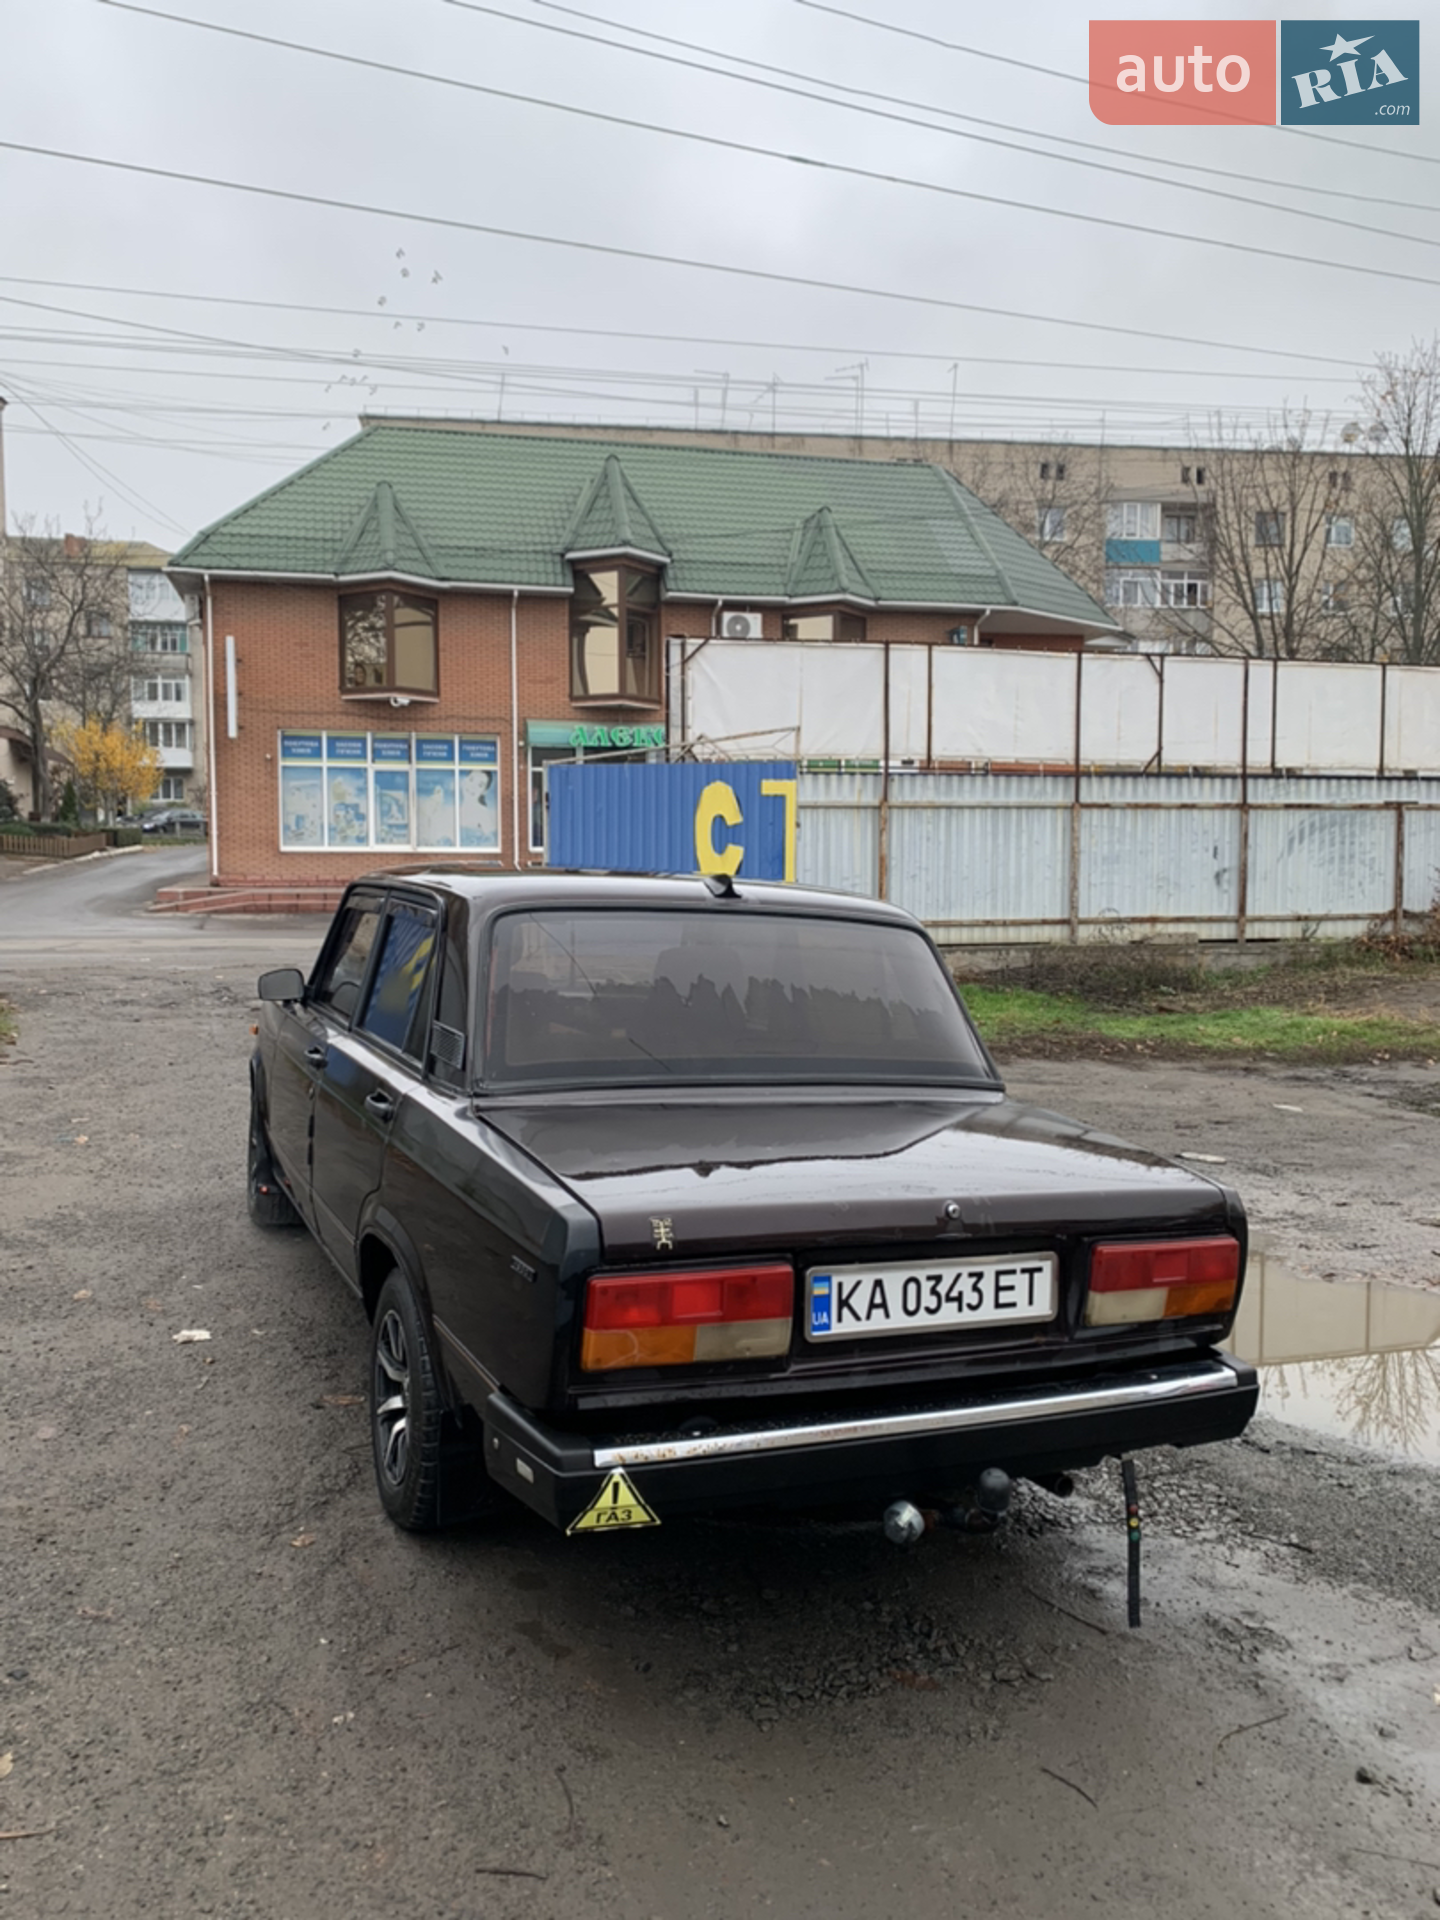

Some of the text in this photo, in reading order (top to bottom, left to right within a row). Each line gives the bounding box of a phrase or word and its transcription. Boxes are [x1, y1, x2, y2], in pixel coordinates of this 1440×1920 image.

[812, 1266, 1044, 1326] UA KA 0343 ET
[595, 1508, 633, 1525] ГАЗ
